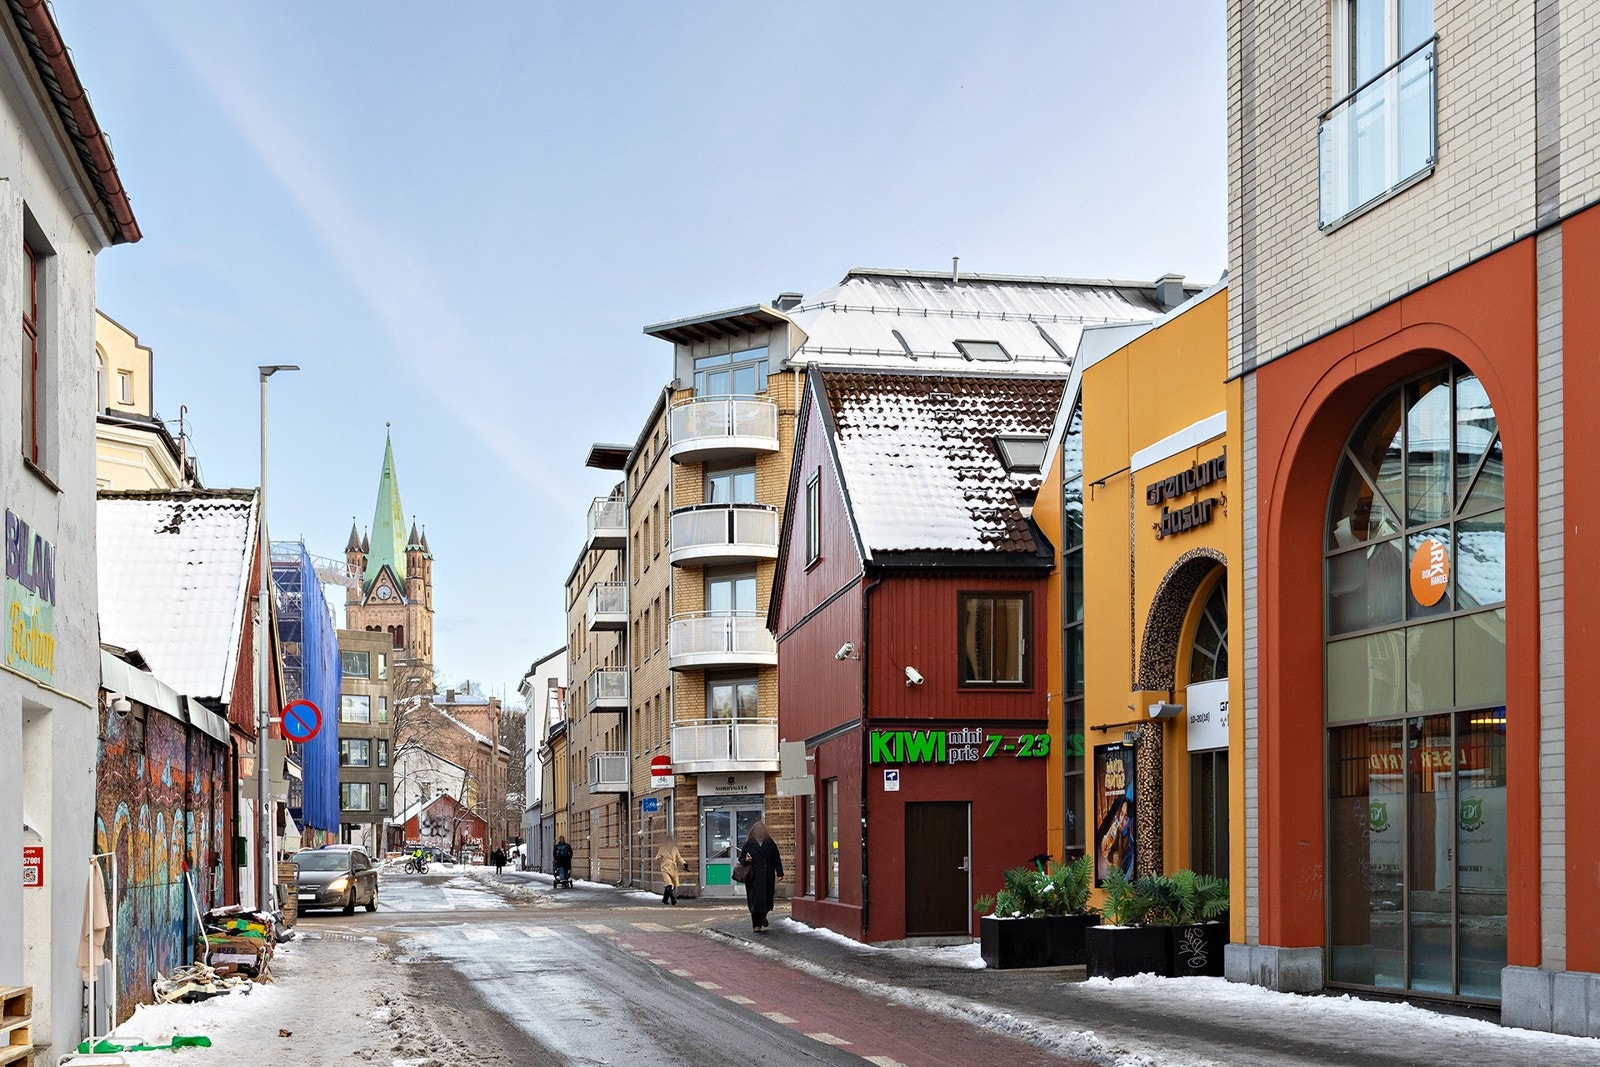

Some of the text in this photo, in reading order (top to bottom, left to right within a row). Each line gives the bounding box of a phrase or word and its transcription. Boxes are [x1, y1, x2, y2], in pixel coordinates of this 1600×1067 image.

[6, 508, 55, 607] BILAN
[1431, 539, 1445, 578] ARK
[7, 601, 55, 675] Fashion
[870, 728, 982, 764] KIWI mini
[949, 745, 979, 764] pris
